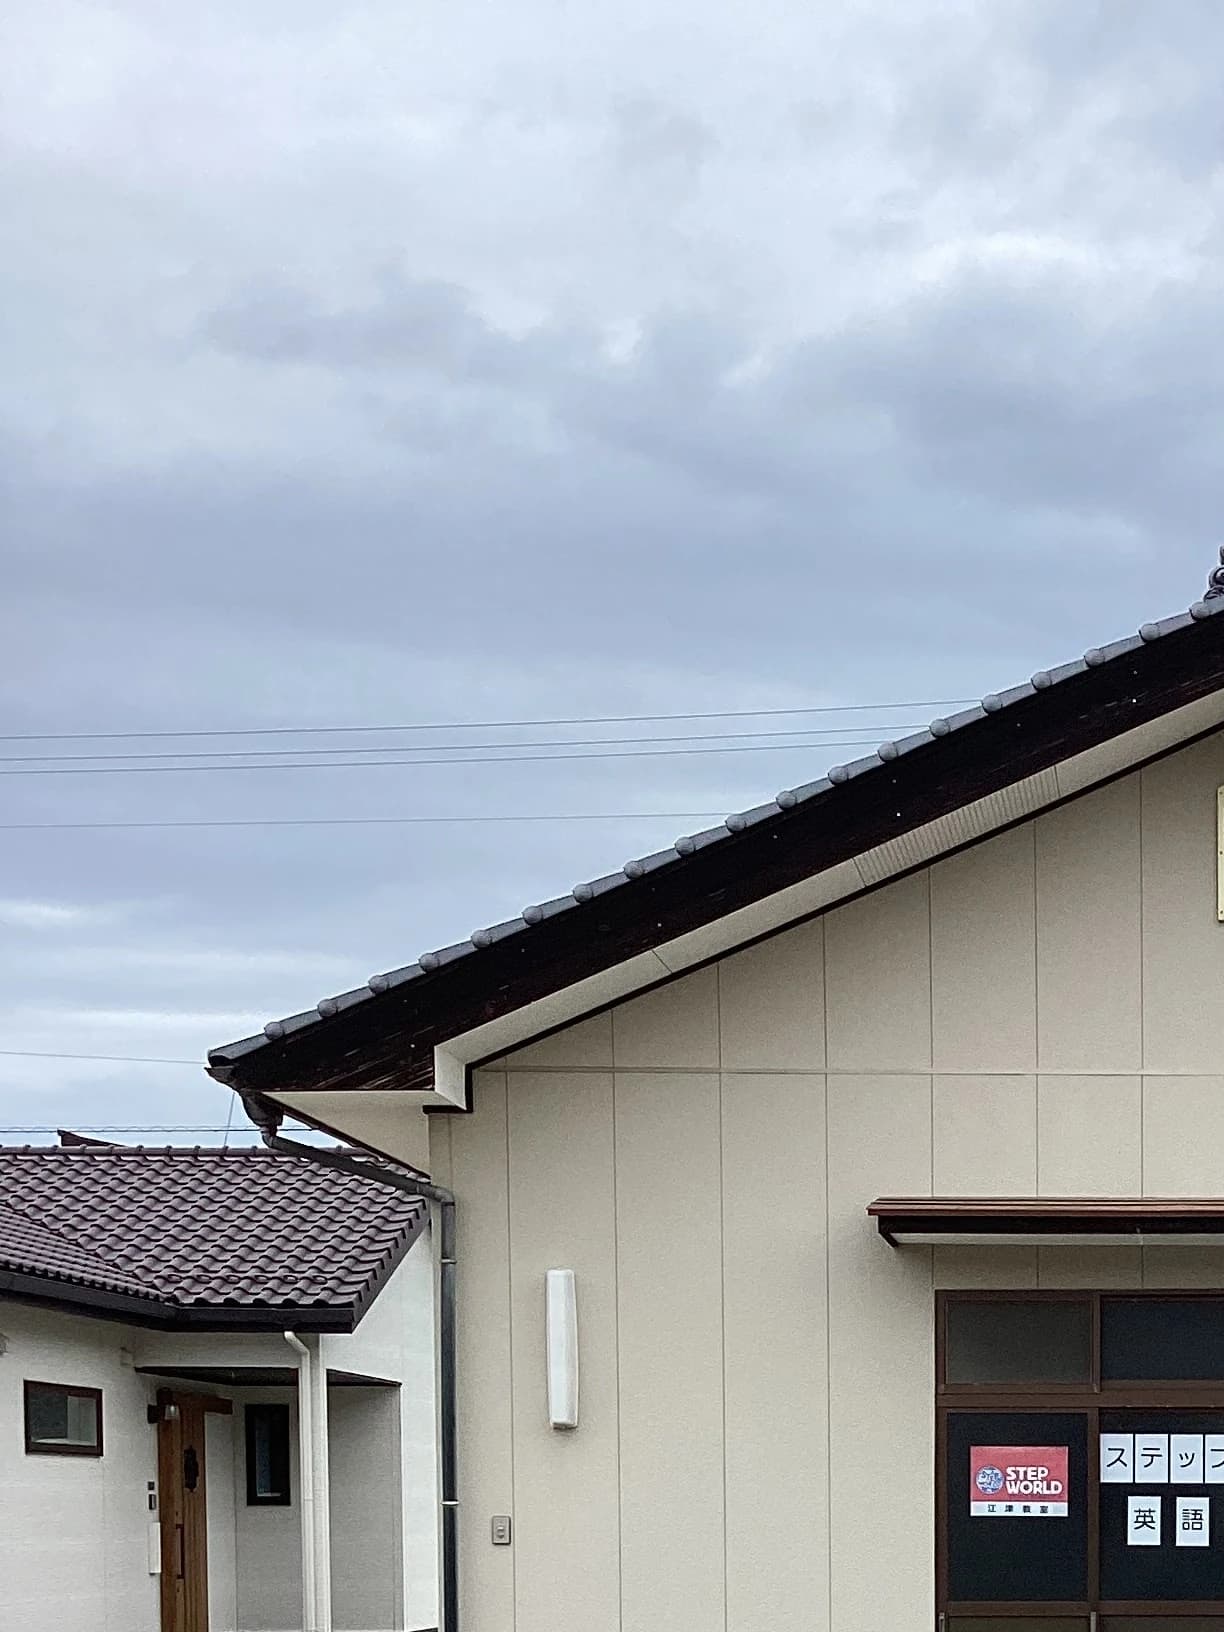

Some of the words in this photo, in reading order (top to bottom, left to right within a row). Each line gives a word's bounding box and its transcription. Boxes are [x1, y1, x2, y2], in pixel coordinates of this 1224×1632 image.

[1006, 1466, 1049, 1480] STEP
[1005, 1480, 1063, 1495] WORLD
[1134, 1508, 1204, 1531] 英語
